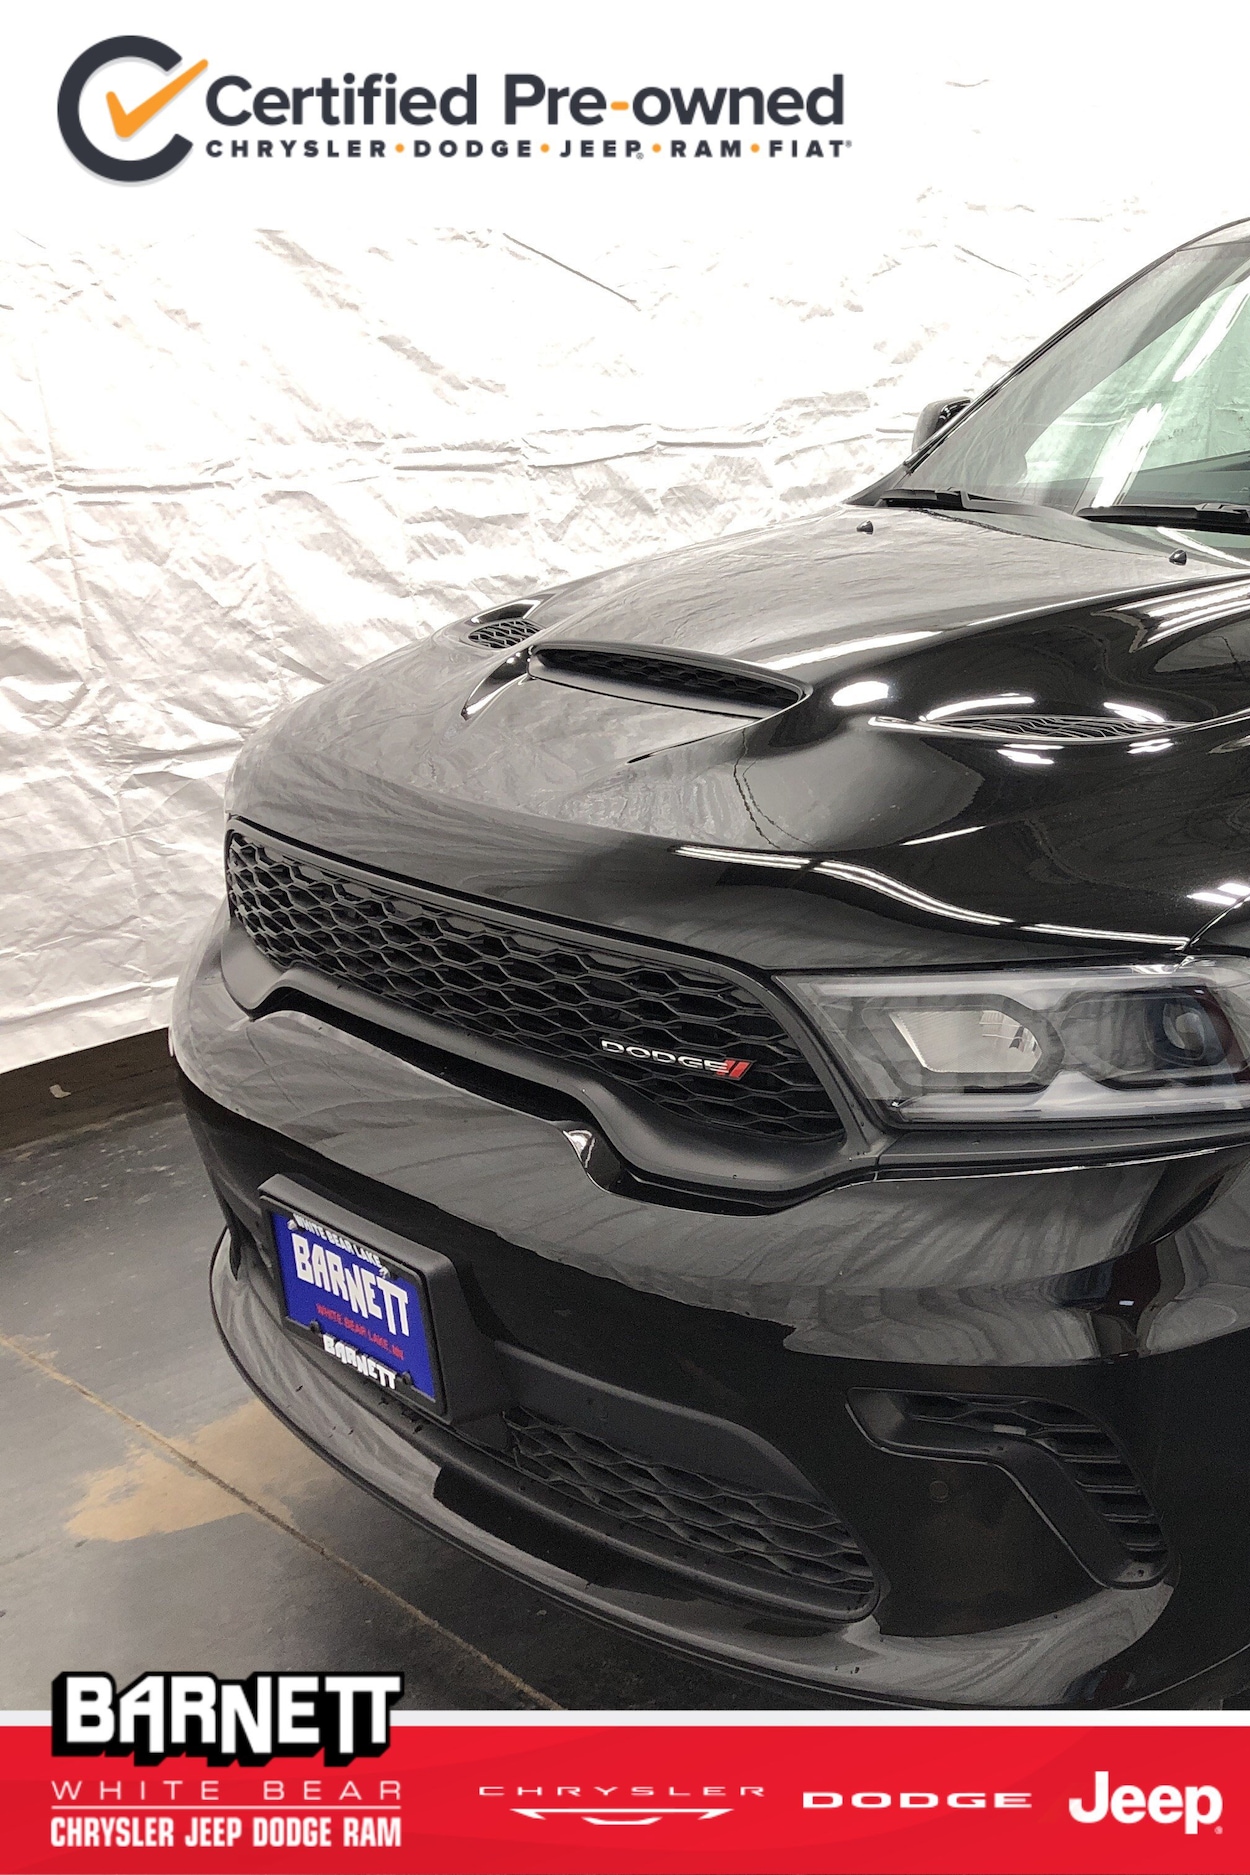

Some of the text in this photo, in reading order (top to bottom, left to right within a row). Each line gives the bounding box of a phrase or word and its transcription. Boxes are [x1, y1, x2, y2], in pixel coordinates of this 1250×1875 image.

[600, 1038, 730, 1075] DODGE
[292, 1212, 383, 1268] WHITE BEAR LAKE
[291, 1232, 410, 1337] BARNETT
[322, 1333, 398, 1390] BARNETT
